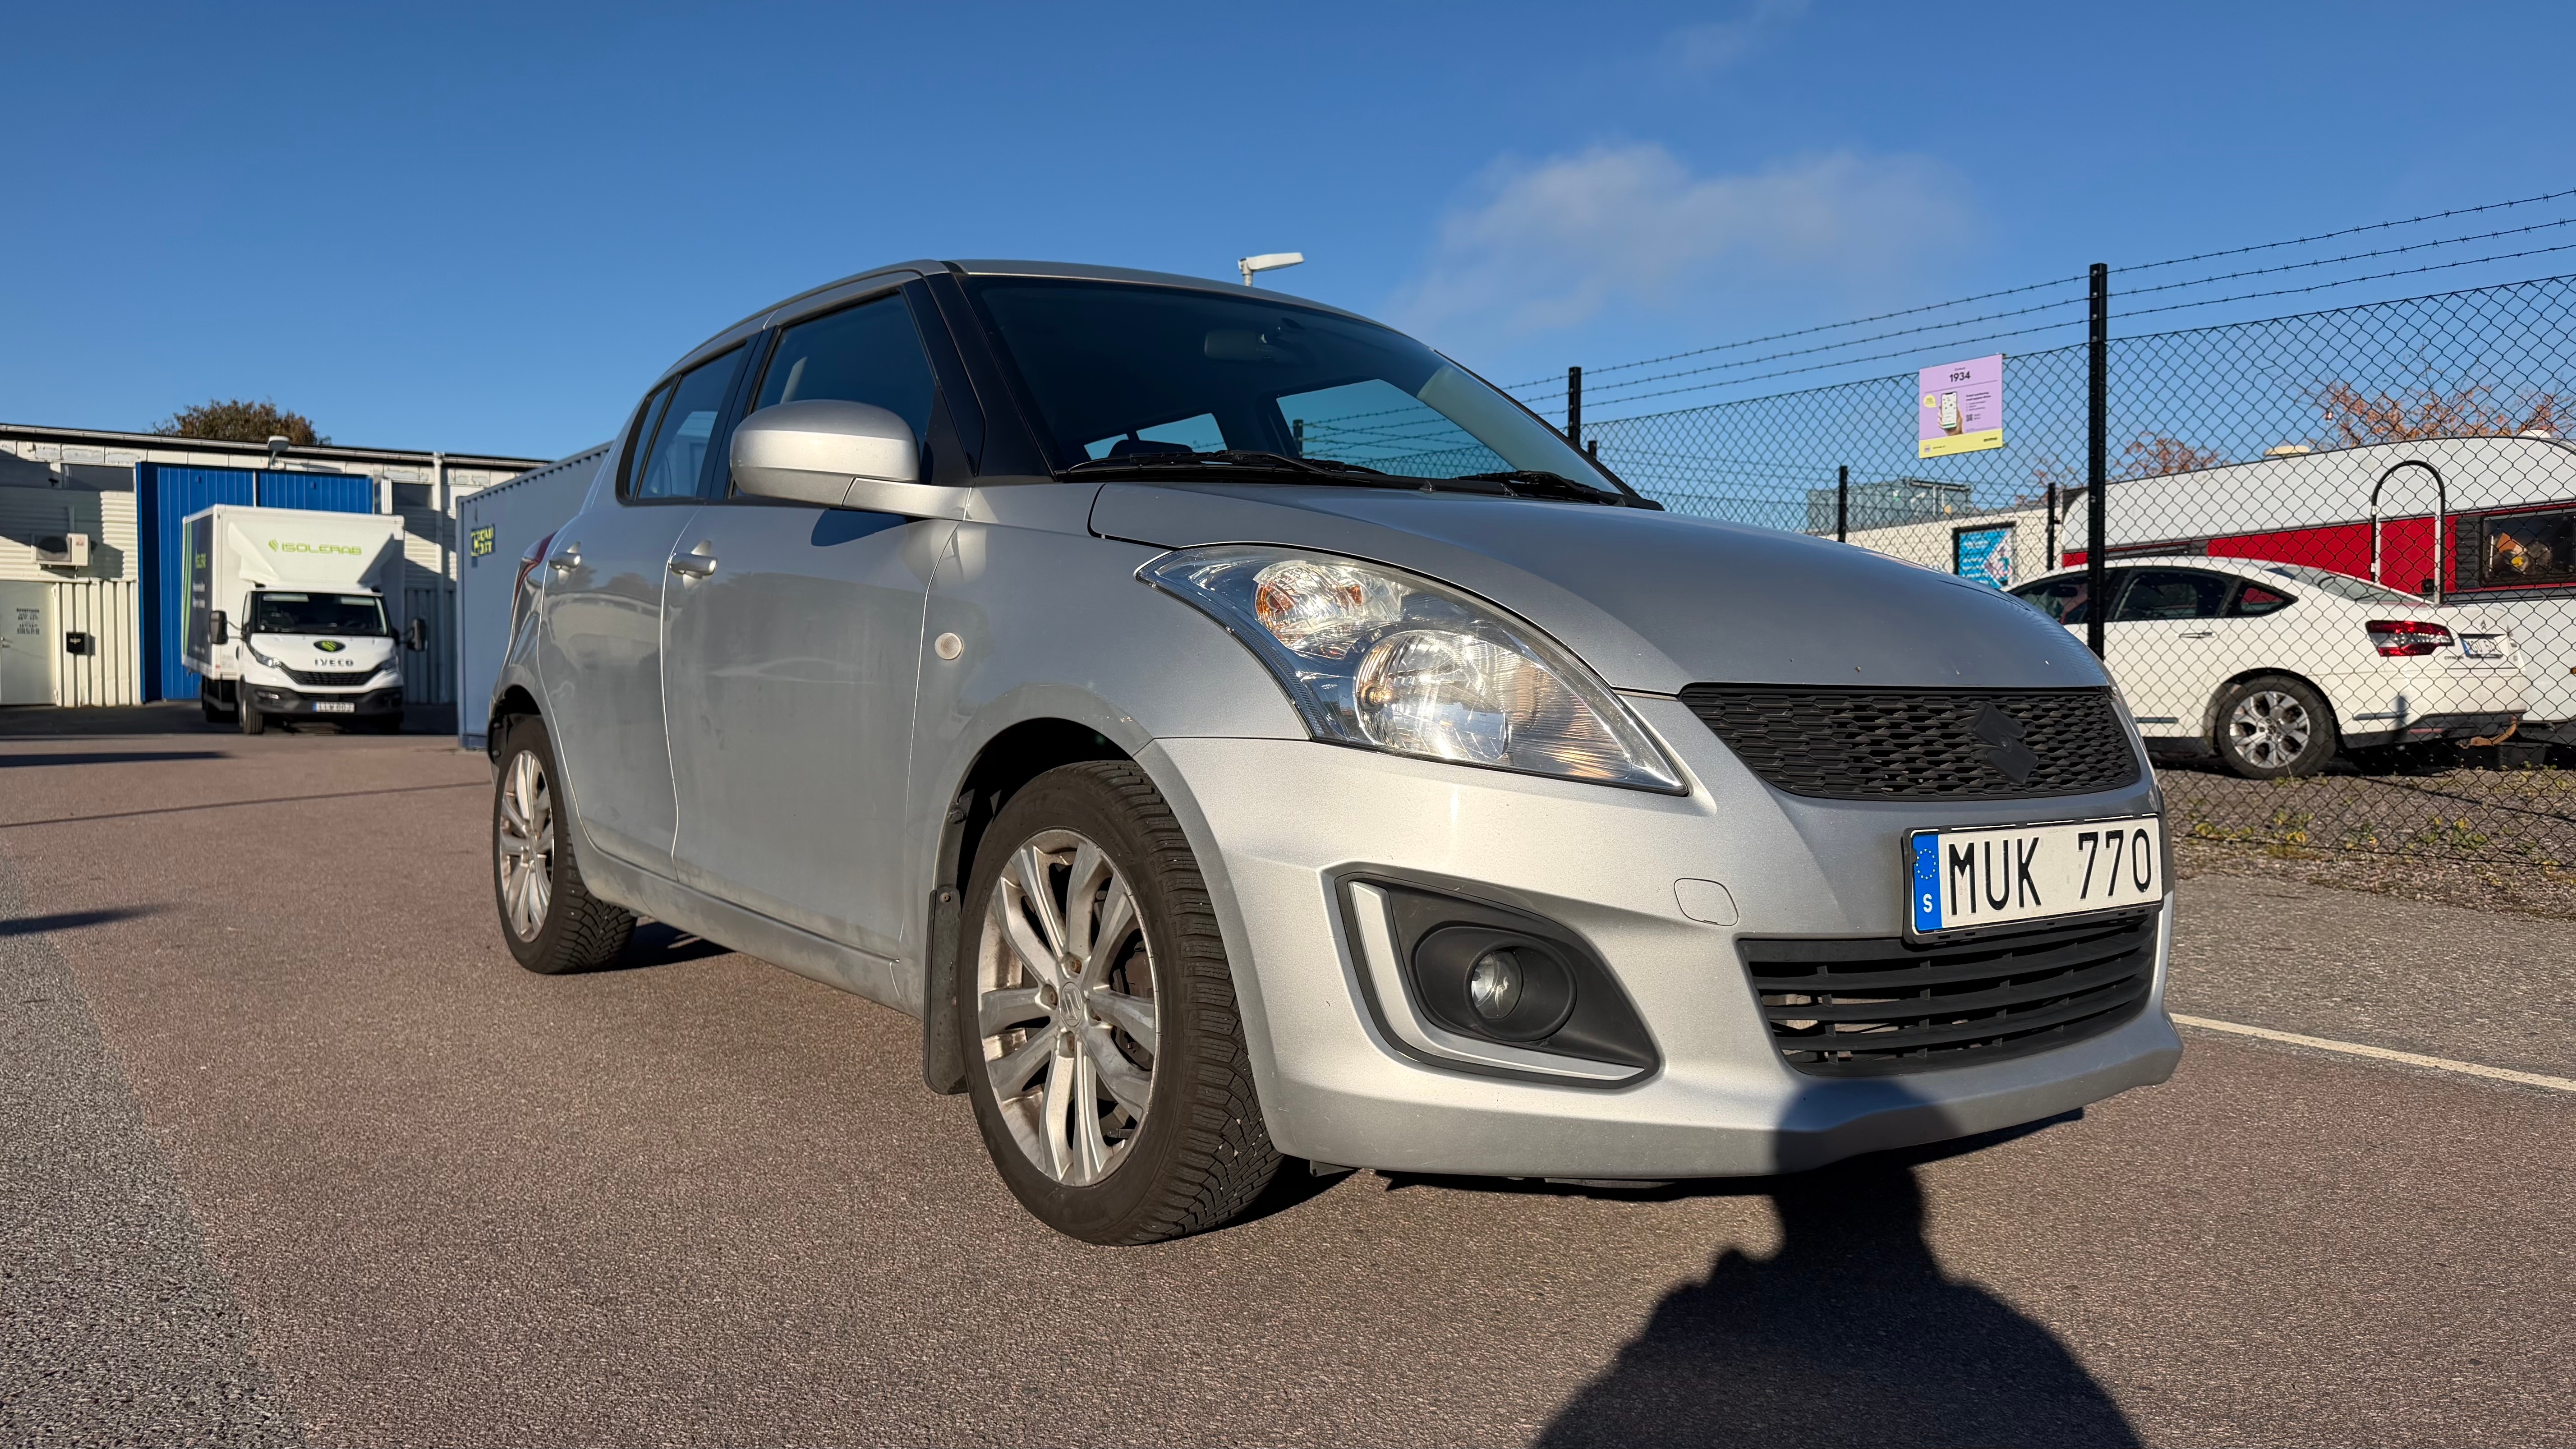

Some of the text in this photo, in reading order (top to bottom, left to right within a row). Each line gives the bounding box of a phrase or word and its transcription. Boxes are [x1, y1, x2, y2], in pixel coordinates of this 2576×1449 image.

[1950, 371, 1970, 382] 1934
[282, 543, 362, 555] ISOLERAB
[315, 658, 353, 667] IVECO
[1949, 828, 2151, 916] MUK 770
[1923, 893, 1932, 913] S
